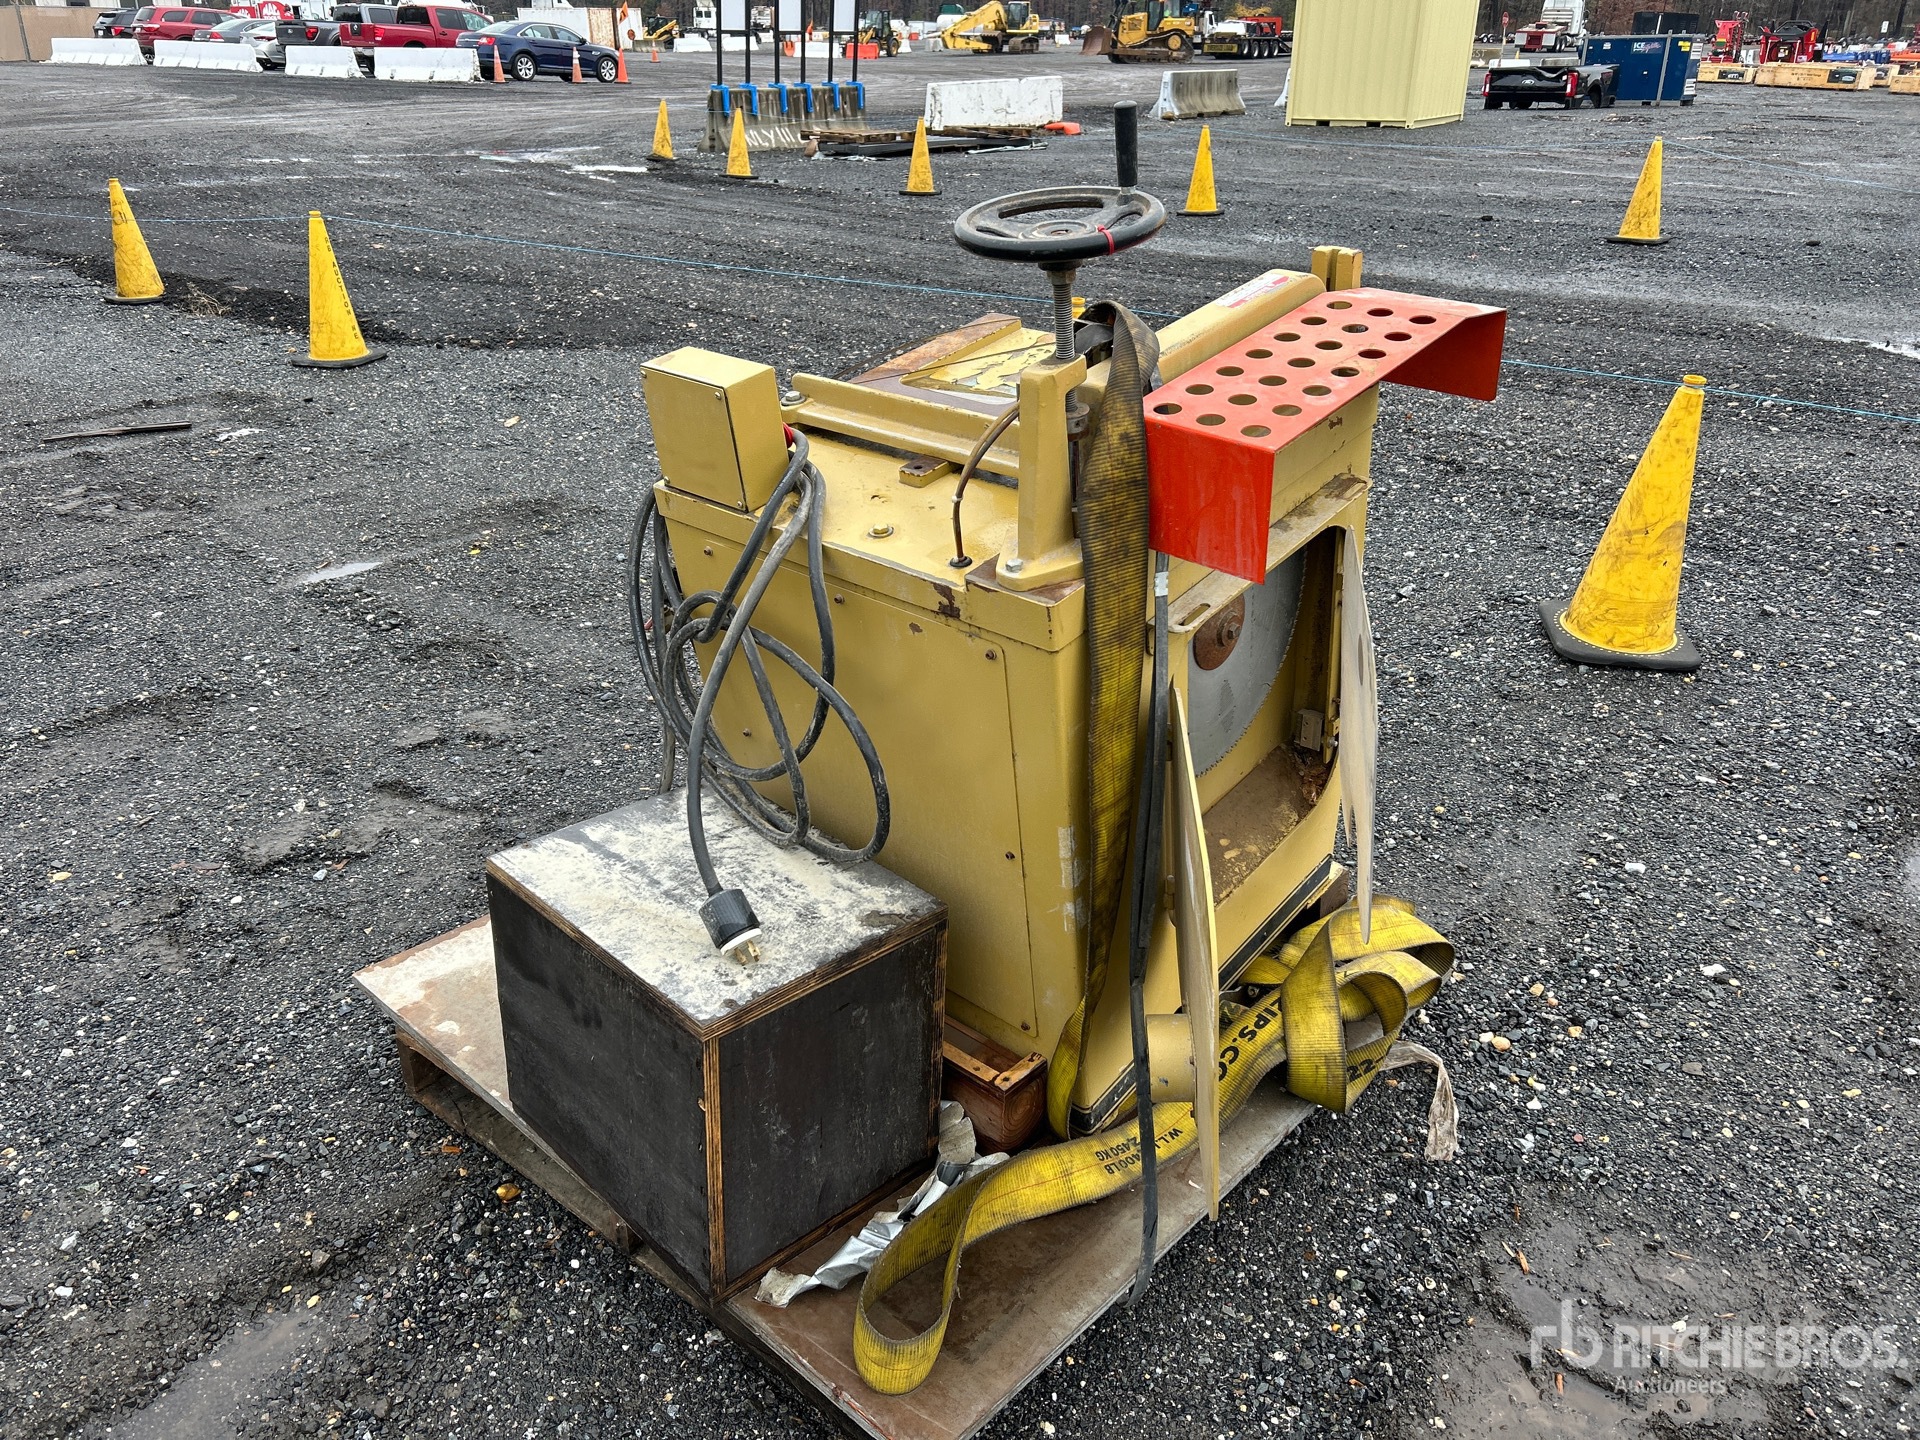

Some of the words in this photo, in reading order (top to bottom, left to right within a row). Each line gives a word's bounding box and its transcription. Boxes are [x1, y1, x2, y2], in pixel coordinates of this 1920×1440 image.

[332, 261, 352, 316] AUCTION
[1095, 1149, 1112, 1162] KG
[1104, 1162, 1121, 1175] LB
